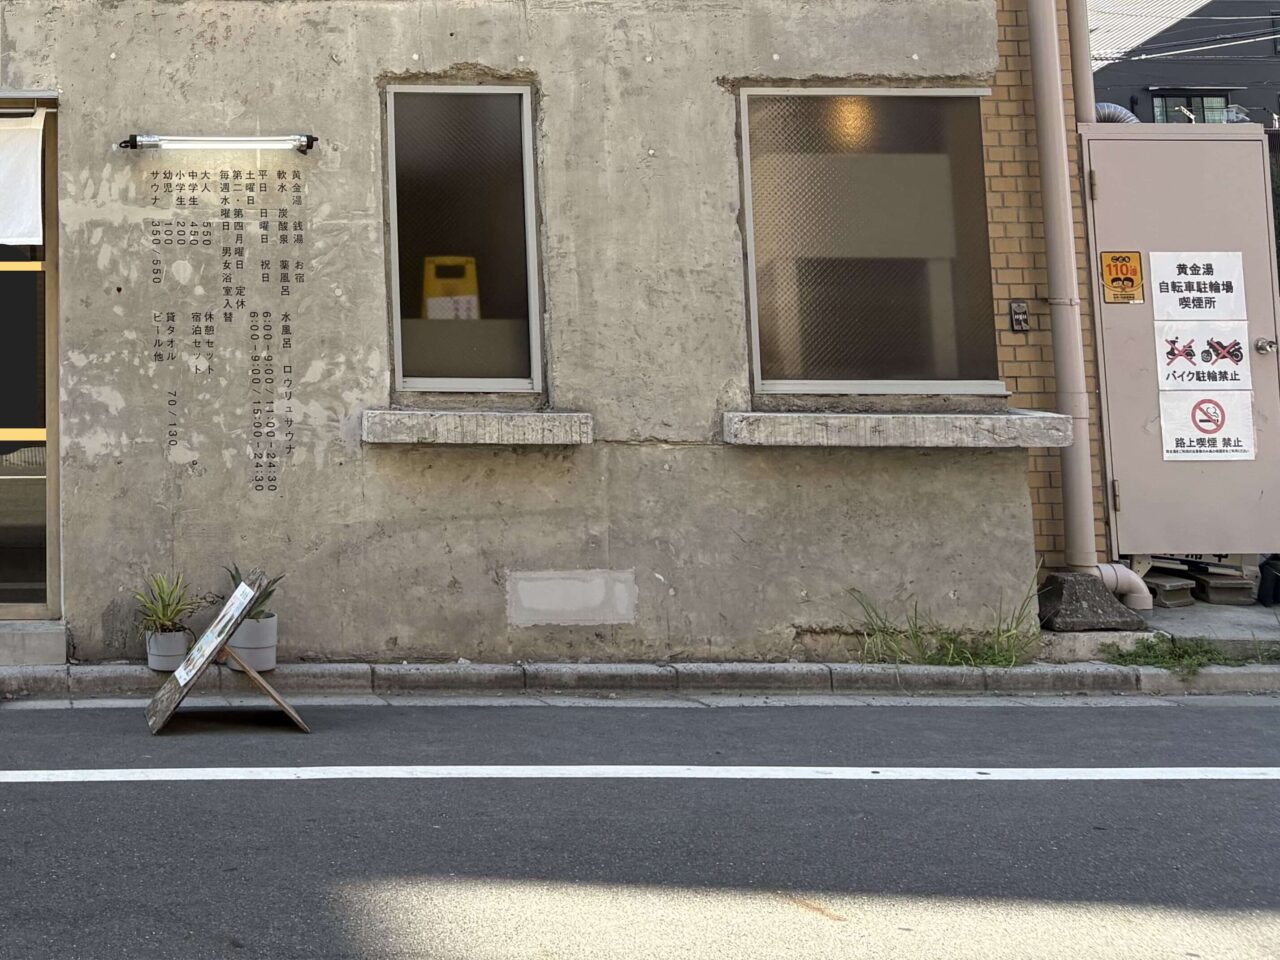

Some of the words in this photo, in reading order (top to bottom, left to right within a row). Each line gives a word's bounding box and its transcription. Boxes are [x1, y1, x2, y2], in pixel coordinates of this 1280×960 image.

[150, 170, 161, 206] サウナ
[163, 170, 173, 193] 幼児
[175, 170, 186, 206] 小学生
[188, 170, 199, 206] 中学生
[200, 170, 211, 193] 大人
[245, 170, 255, 206] 土曜日
[258, 170, 268, 192] 平日
[277, 170, 288, 193] 軟水
[291, 170, 303, 206] 黄金湯
[220, 170, 231, 231] 毎週水曜日
[164, 222, 174, 246] 100
[176, 221, 186, 246] 200
[189, 221, 199, 246] 450
[202, 221, 212, 246] 550
[260, 208, 269, 244] 日曜日
[278, 208, 289, 244] 炭酸泉
[293, 221, 304, 245] 銭湯
[261, 260, 270, 283] 祝日
[279, 260, 291, 297] 薬風呂
[294, 260, 305, 283] お宿
[1176, 263, 1214, 276] 黄金湯
[222, 247, 234, 323] 男女浴室入替
[235, 286, 246, 309] 定休
[1159, 281, 1234, 294] 自転車駐輪場
[1178, 296, 1216, 309] 喫煙所
[153, 312, 164, 362] ビール他
[166, 312, 177, 362] 貸タオル
[191, 312, 203, 374] 宿泊セット
[204, 312, 215, 374] 休憩セット
[281, 312, 292, 349] 水風呂
[1166, 370, 1241, 382] バイク駐輪禁止
[283, 365, 295, 455] ロウリュサウナ
[1174, 437, 1218, 448] 路上喫煙
[1222, 437, 1243, 448] 禁止
